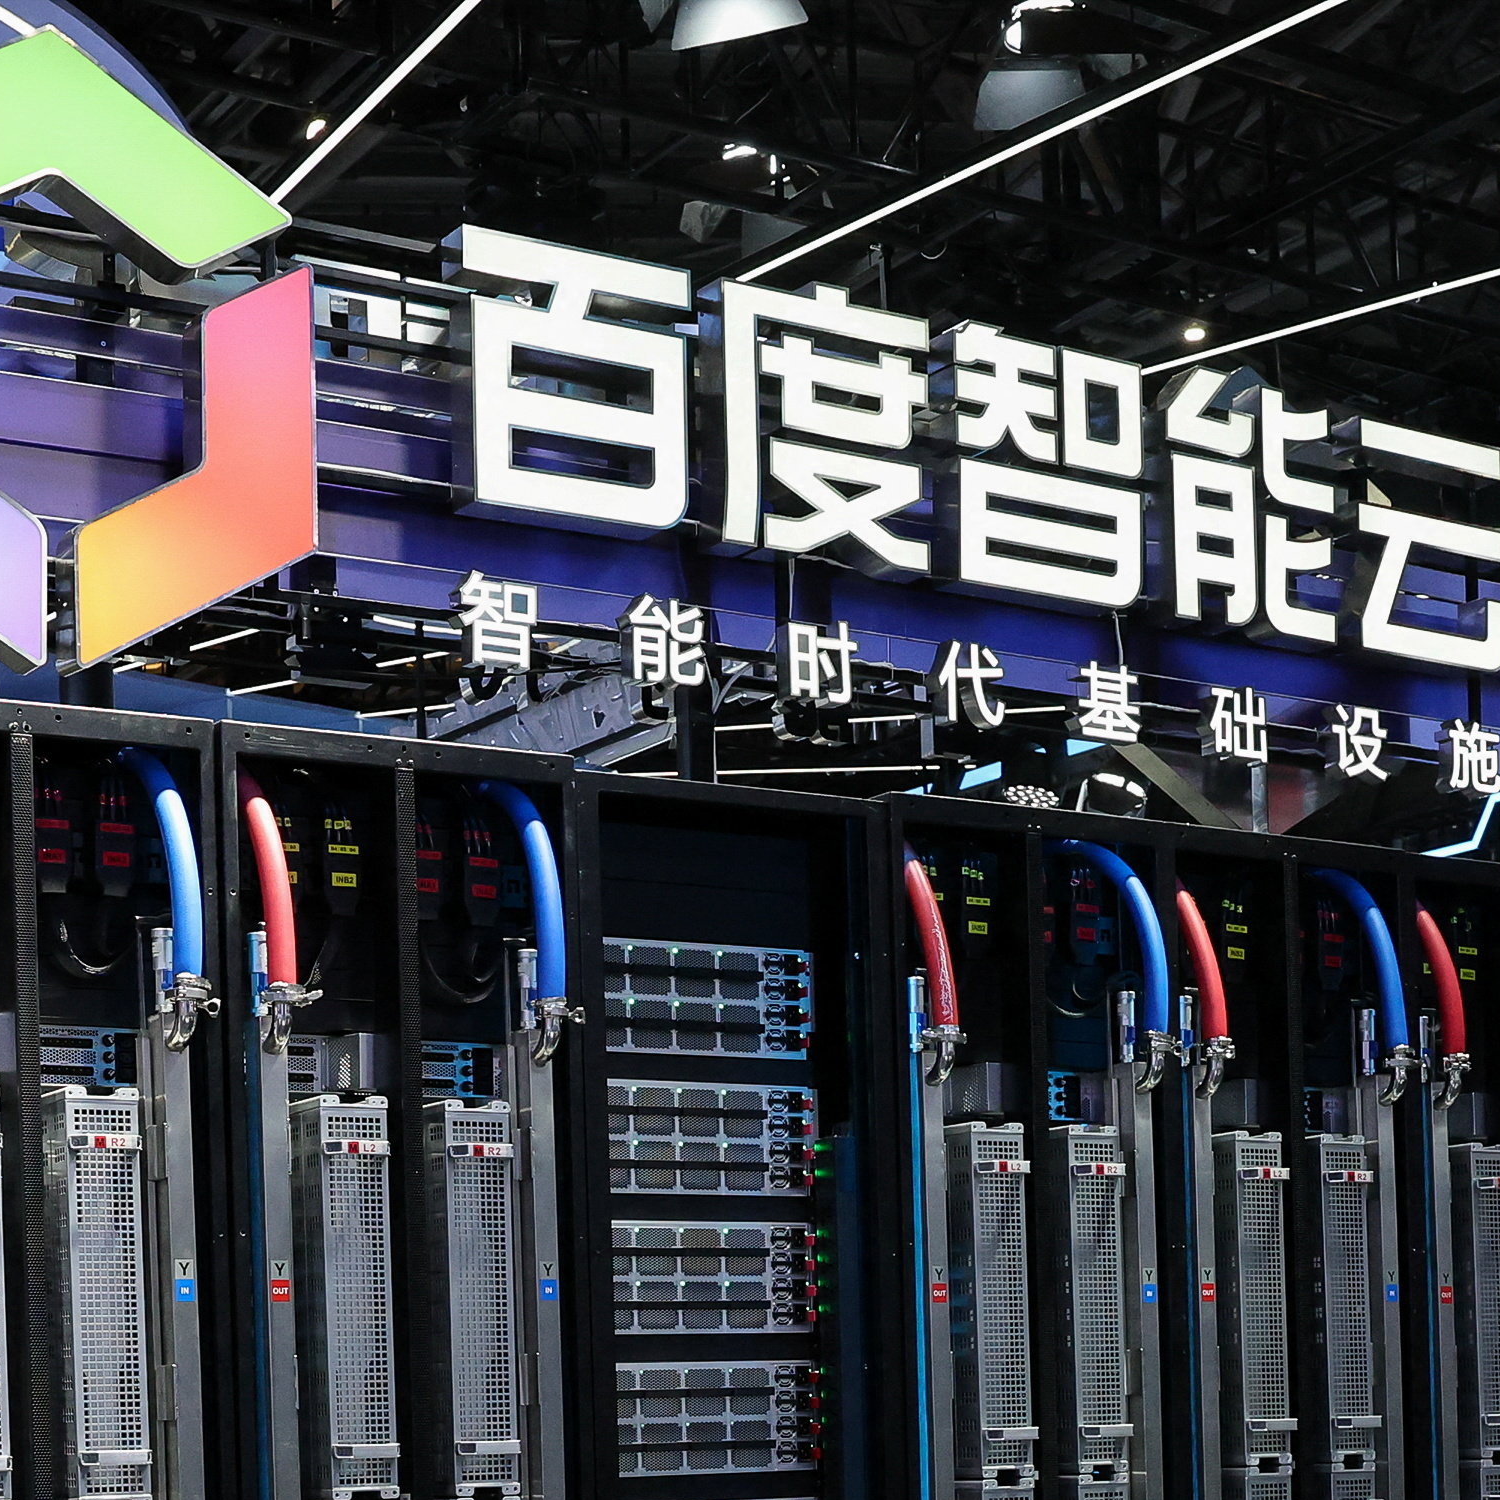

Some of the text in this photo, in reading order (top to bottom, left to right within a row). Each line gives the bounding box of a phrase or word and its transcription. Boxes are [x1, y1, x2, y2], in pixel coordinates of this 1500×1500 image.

[335, 875, 354, 885] INB2
[112, 1138, 126, 1147] R2
[364, 1143, 376, 1152] L2
[488, 1147, 501, 1155] R2
[1011, 1163, 1021, 1171] L2
[1107, 1166, 1118, 1174] R2
[1273, 1170, 1283, 1178] L2
[1358, 1173, 1367, 1181] R2
[179, 1262, 190, 1276] Y
[274, 1263, 285, 1276] Y
[543, 1263, 553, 1276] Y
[935, 1268, 943, 1280] Y
[1145, 1270, 1153, 1281] Y
[1204, 1269, 1211, 1280] Y
[1388, 1270, 1395, 1281] Y
[1443, 1273, 1449, 1284] Y
[180, 1286, 189, 1294] IN
[273, 1287, 288, 1295] OUT
